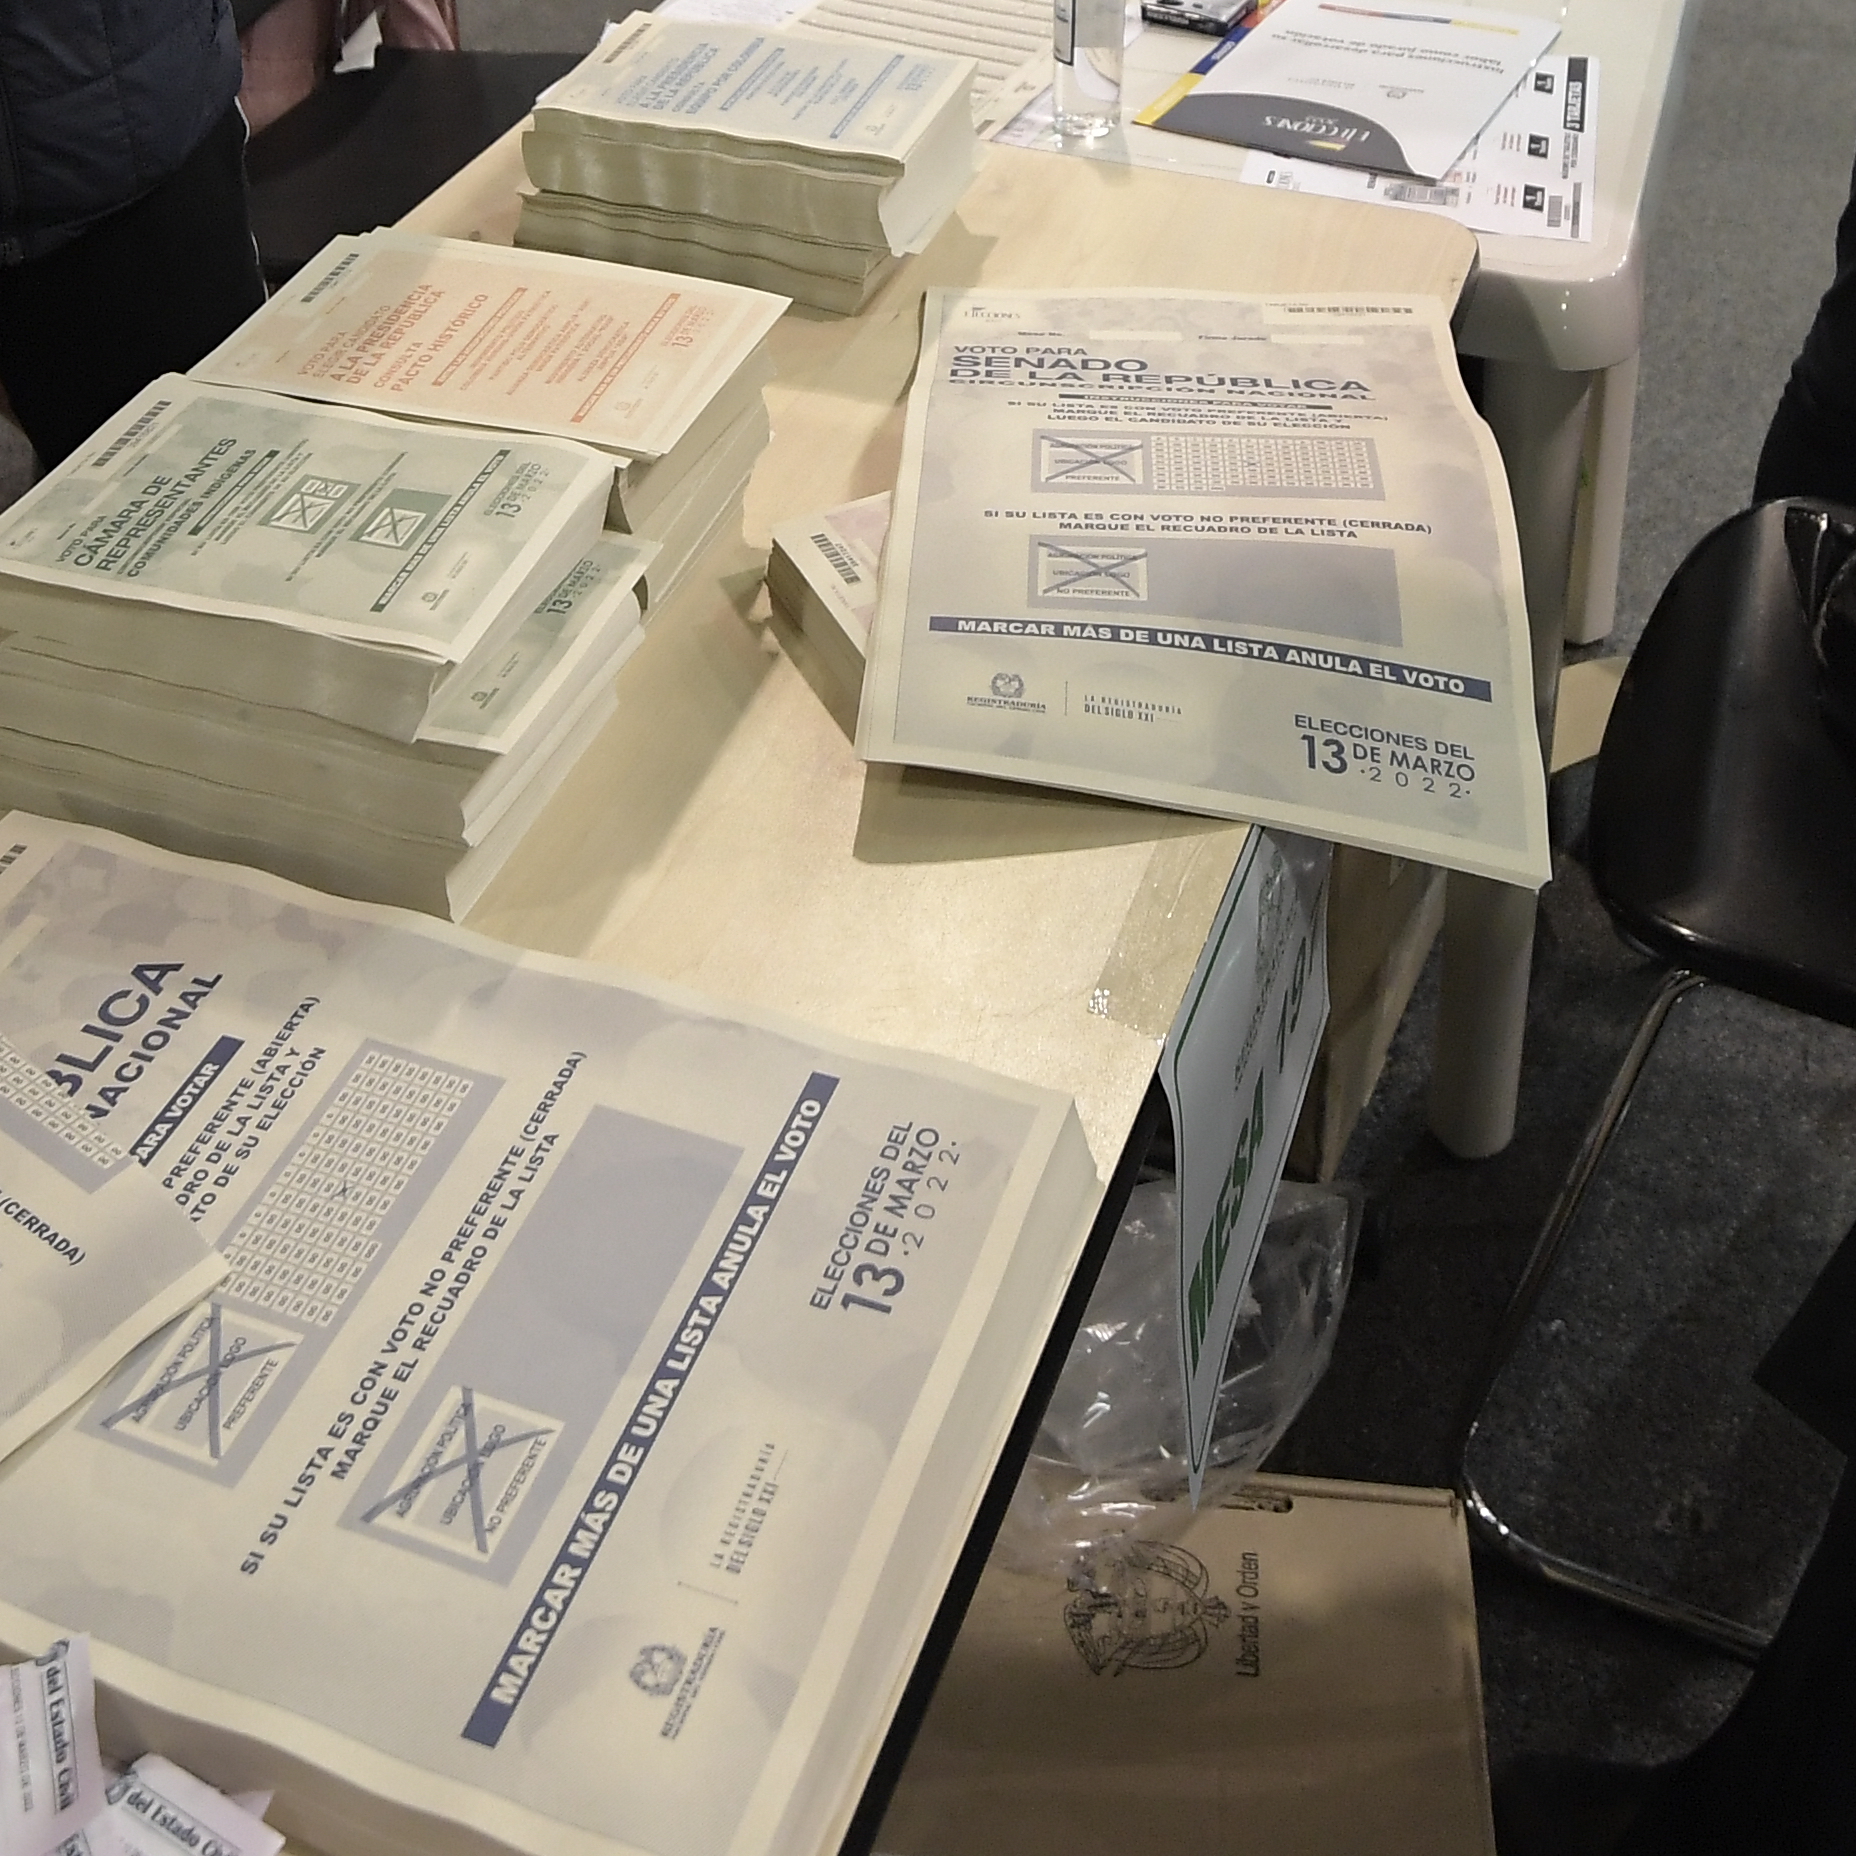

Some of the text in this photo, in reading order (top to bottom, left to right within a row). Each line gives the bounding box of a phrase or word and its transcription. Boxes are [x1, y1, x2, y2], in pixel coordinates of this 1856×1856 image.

[326, 283, 433, 381] A LA PRESIDENCIA
[389, 353, 435, 391] PACTO
[425, 293, 491, 351] HISTÓRICO
[668, 334, 697, 348] 13
[950, 353, 1149, 373] SENADO
[952, 345, 1089, 355] VOTO PARA
[344, 368, 371, 384] DE
[362, 351, 387, 366] LA
[369, 341, 425, 388] CONSULTA
[947, 367, 1372, 390] DE LA REPÚBLICA
[1225, 388, 1378, 401] NACIONAL
[71, 498, 151, 566] CÁMARA
[140, 475, 172, 496] DE
[94, 438, 243, 570] REPRESENTANTES
[124, 501, 206, 576] COMUNIDADES
[201, 448, 256, 498] INDÍGENAS
[491, 500, 526, 520] 13
[983, 509, 1433, 534] SI SU LISTA ES CON VOTO NO PREFERENTE (CERRADA)
[1058, 522, 1358, 539] MARQUE EL RECUADRO DE LA LISTA
[54, 538, 84, 562] VOTO
[80, 514, 107, 536] PARA
[957, 621, 1467, 695] MARCAR MÁS DE UNA LISTA ANULA EL VOTO
[1293, 713, 1477, 762] ELECCIONES DEL
[1299, 733, 1478, 784] 13 DE MARZO
[159, 995, 322, 1188] PREFERENTE (ABIERTA)
[165, 1060, 220, 1119] VOTAR
[806, 1114, 917, 1313] ELECCIONES DEL
[832, 1122, 942, 1327] 13 DE MARZO
[1188, 1066, 1263, 1380] MESA
[236, 1047, 593, 1577] SI SU LISTA ES CON VOTO NO PREFERENTE (CERRADA)
[327, 1128, 562, 1483] MARQUE EL RECUADRO DE LA LISTA
[488, 1095, 822, 1707] MARCAR MÁS DE UNA LISTA ANULA EL VOTO
[723, 1544, 751, 1576] DEL
[737, 1505, 769, 1549] SIGLO
[1235, 1551, 1261, 1599] Orden
[1235, 1615, 1261, 1678] Libertad
[45, 1664, 63, 1695] del
[48, 1696, 71, 1764] Estado
[125, 1786, 205, 1848] del Estado
